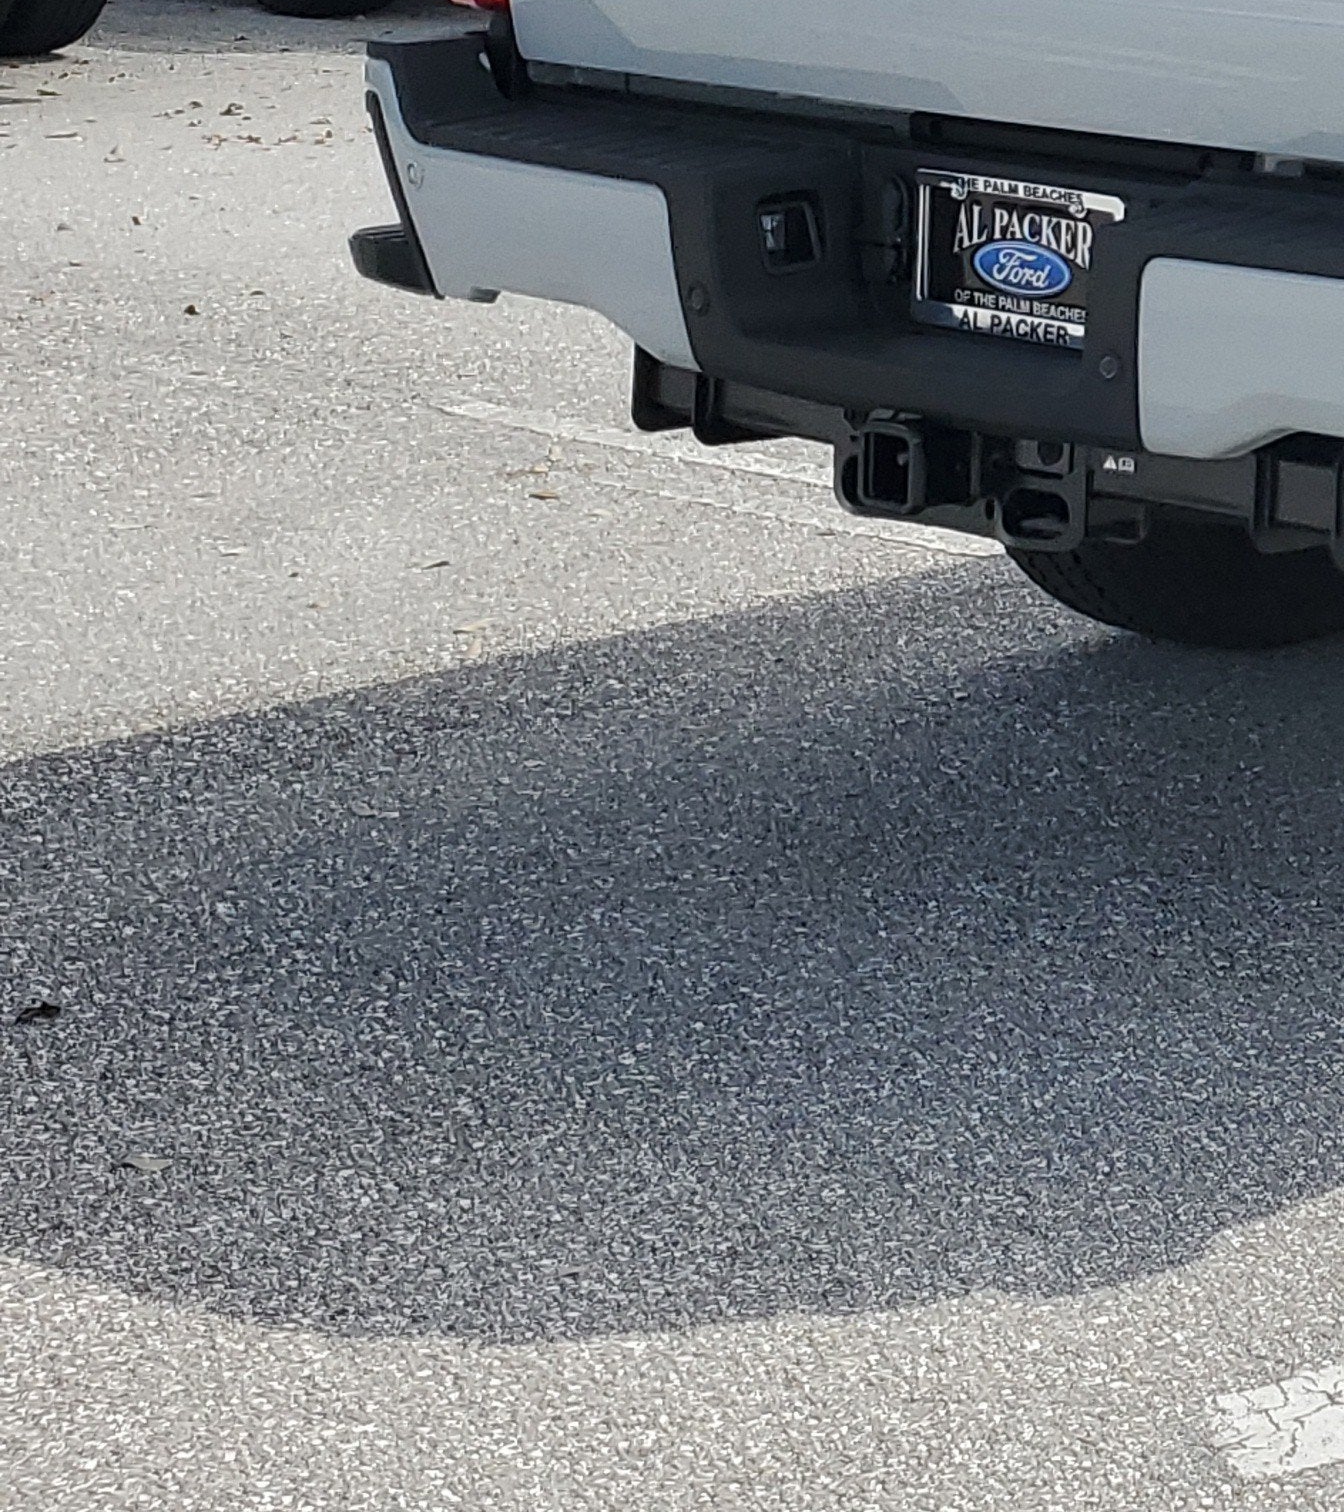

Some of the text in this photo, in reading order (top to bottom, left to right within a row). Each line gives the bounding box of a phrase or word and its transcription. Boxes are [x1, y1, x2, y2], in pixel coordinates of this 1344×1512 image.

[984, 178, 1020, 195] PALM
[1023, 185, 1083, 202] BEACHES
[952, 202, 1094, 270] AL PACKER
[993, 249, 1049, 287] Ford
[954, 288, 971, 303] OF
[973, 291, 997, 308] THE
[998, 296, 1030, 313] PALM
[959, 308, 1070, 346] AL PACKER
